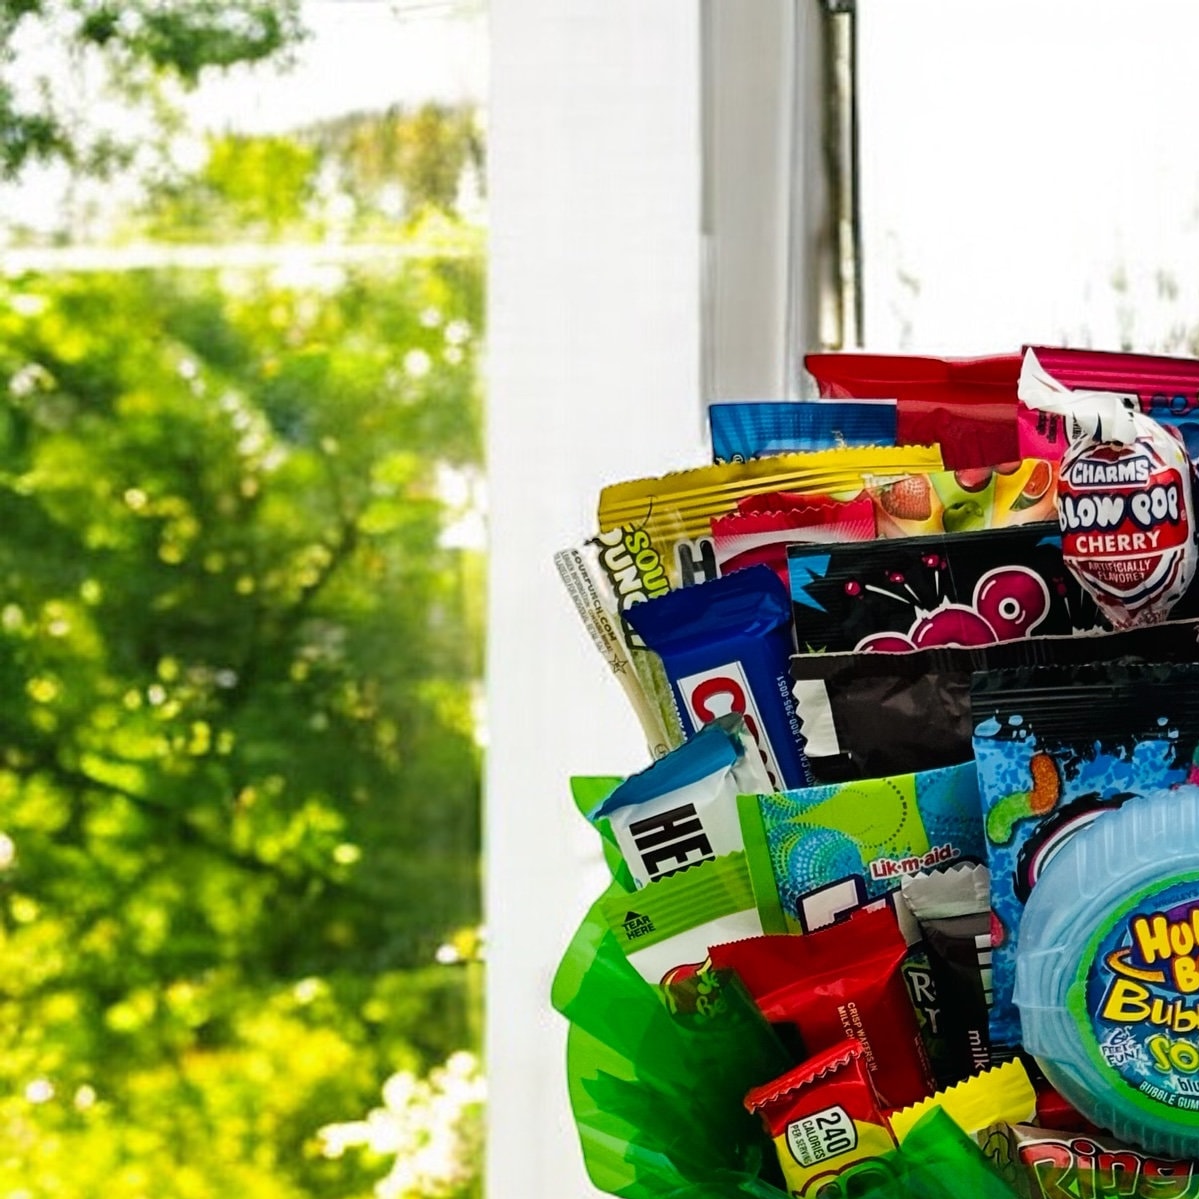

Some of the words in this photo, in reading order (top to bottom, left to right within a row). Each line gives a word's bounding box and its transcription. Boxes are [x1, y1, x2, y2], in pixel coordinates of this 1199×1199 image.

[1073, 458, 1150, 485] CHARMS
[1060, 495, 1125, 532] BLOW
[1131, 486, 1178, 526] POP
[1075, 530, 1161, 554] CHERRY
[625, 529, 671, 600] SOU
[1088, 558, 1151, 572] ARTIFICIALLY
[622, 916, 651, 932] TEAR
[626, 923, 656, 940] HERE
[837, 1005, 851, 1028] MILK
[847, 1002, 863, 1028] CRISP
[968, 1030, 991, 1069] milk
[1140, 1080, 1175, 1105] BUBBLE
[1177, 1098, 1199, 1111] GUM
[791, 1124, 801, 1140] PER
[797, 1139, 813, 1165] SERVING
[802, 1120, 826, 1160] CALORIES
[816, 1112, 852, 1155] 240
